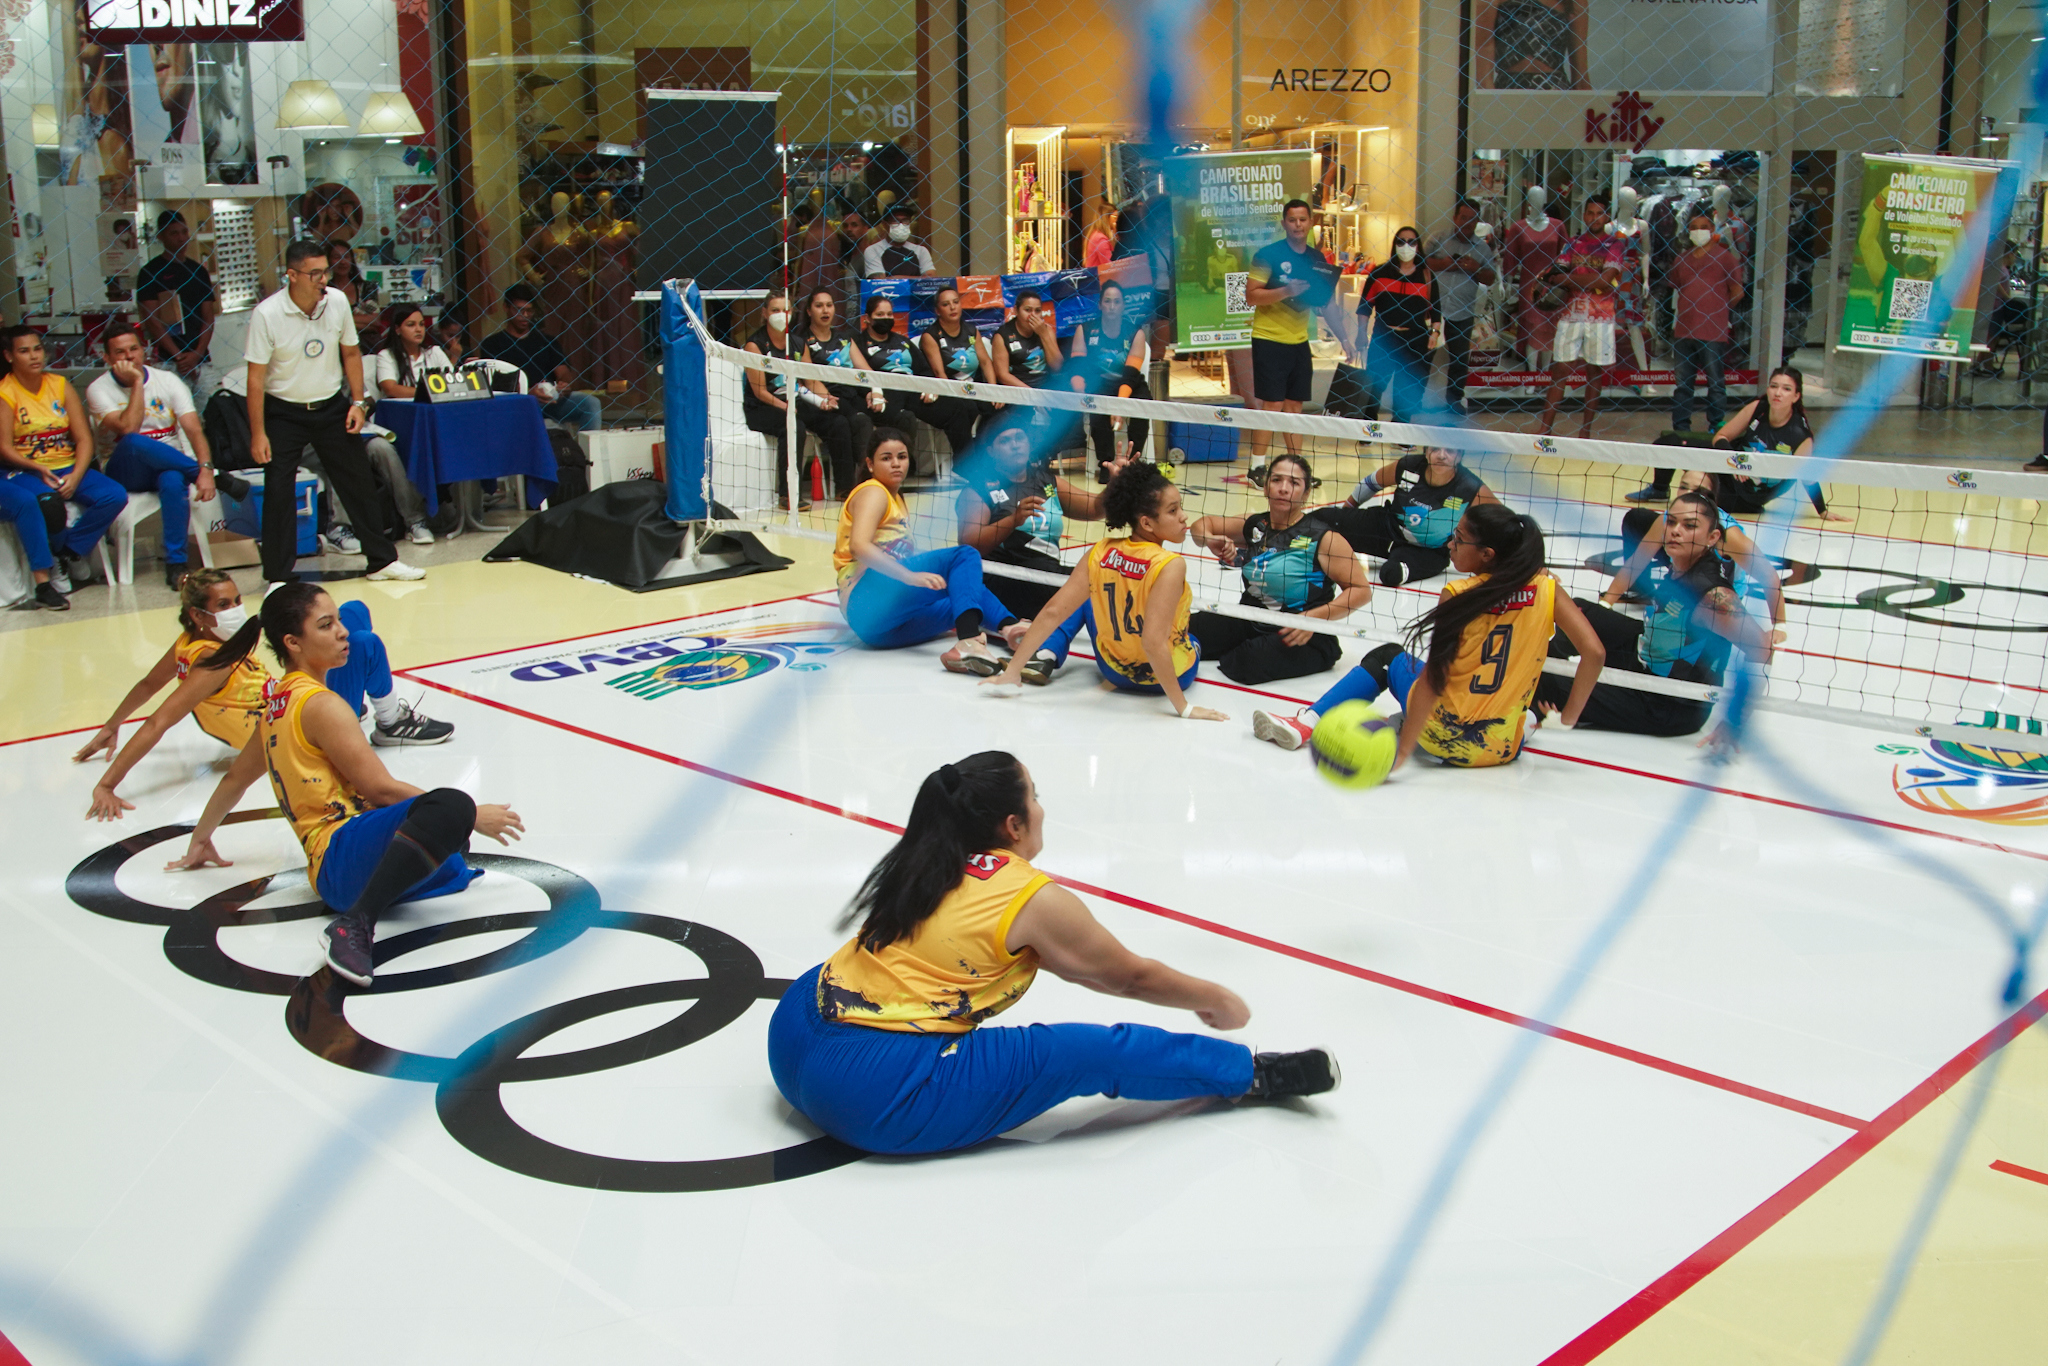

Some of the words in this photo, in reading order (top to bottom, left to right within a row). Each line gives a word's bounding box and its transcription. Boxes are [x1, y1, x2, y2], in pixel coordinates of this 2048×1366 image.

[142, 0, 257, 28] DINIZ
[1269, 68, 1391, 92] AREZZO
[161, 148, 184, 164] BOSS
[1200, 164, 1282, 184] CAMPEONATO
[1890, 172, 1968, 196] CAMPEONATO
[1201, 182, 1284, 204] BRASILEIRO
[1886, 190, 1966, 215] BRASILEIRO
[1201, 206, 1212, 217] de
[1213, 204, 1248, 217] Voleibol
[1249, 202, 1284, 215] Sentado
[1884, 210, 1895, 221] de
[1896, 211, 1928, 224] Voleibol
[1929, 214, 1962, 228] Sentado
[428, 373, 447, 394] 0
[466, 371, 480, 390] 1
[19, 407, 30, 425] 2
[1103, 582, 1145, 641] 14
[510, 636, 728, 682] CBVD
[1469, 623, 1513, 695] 9
